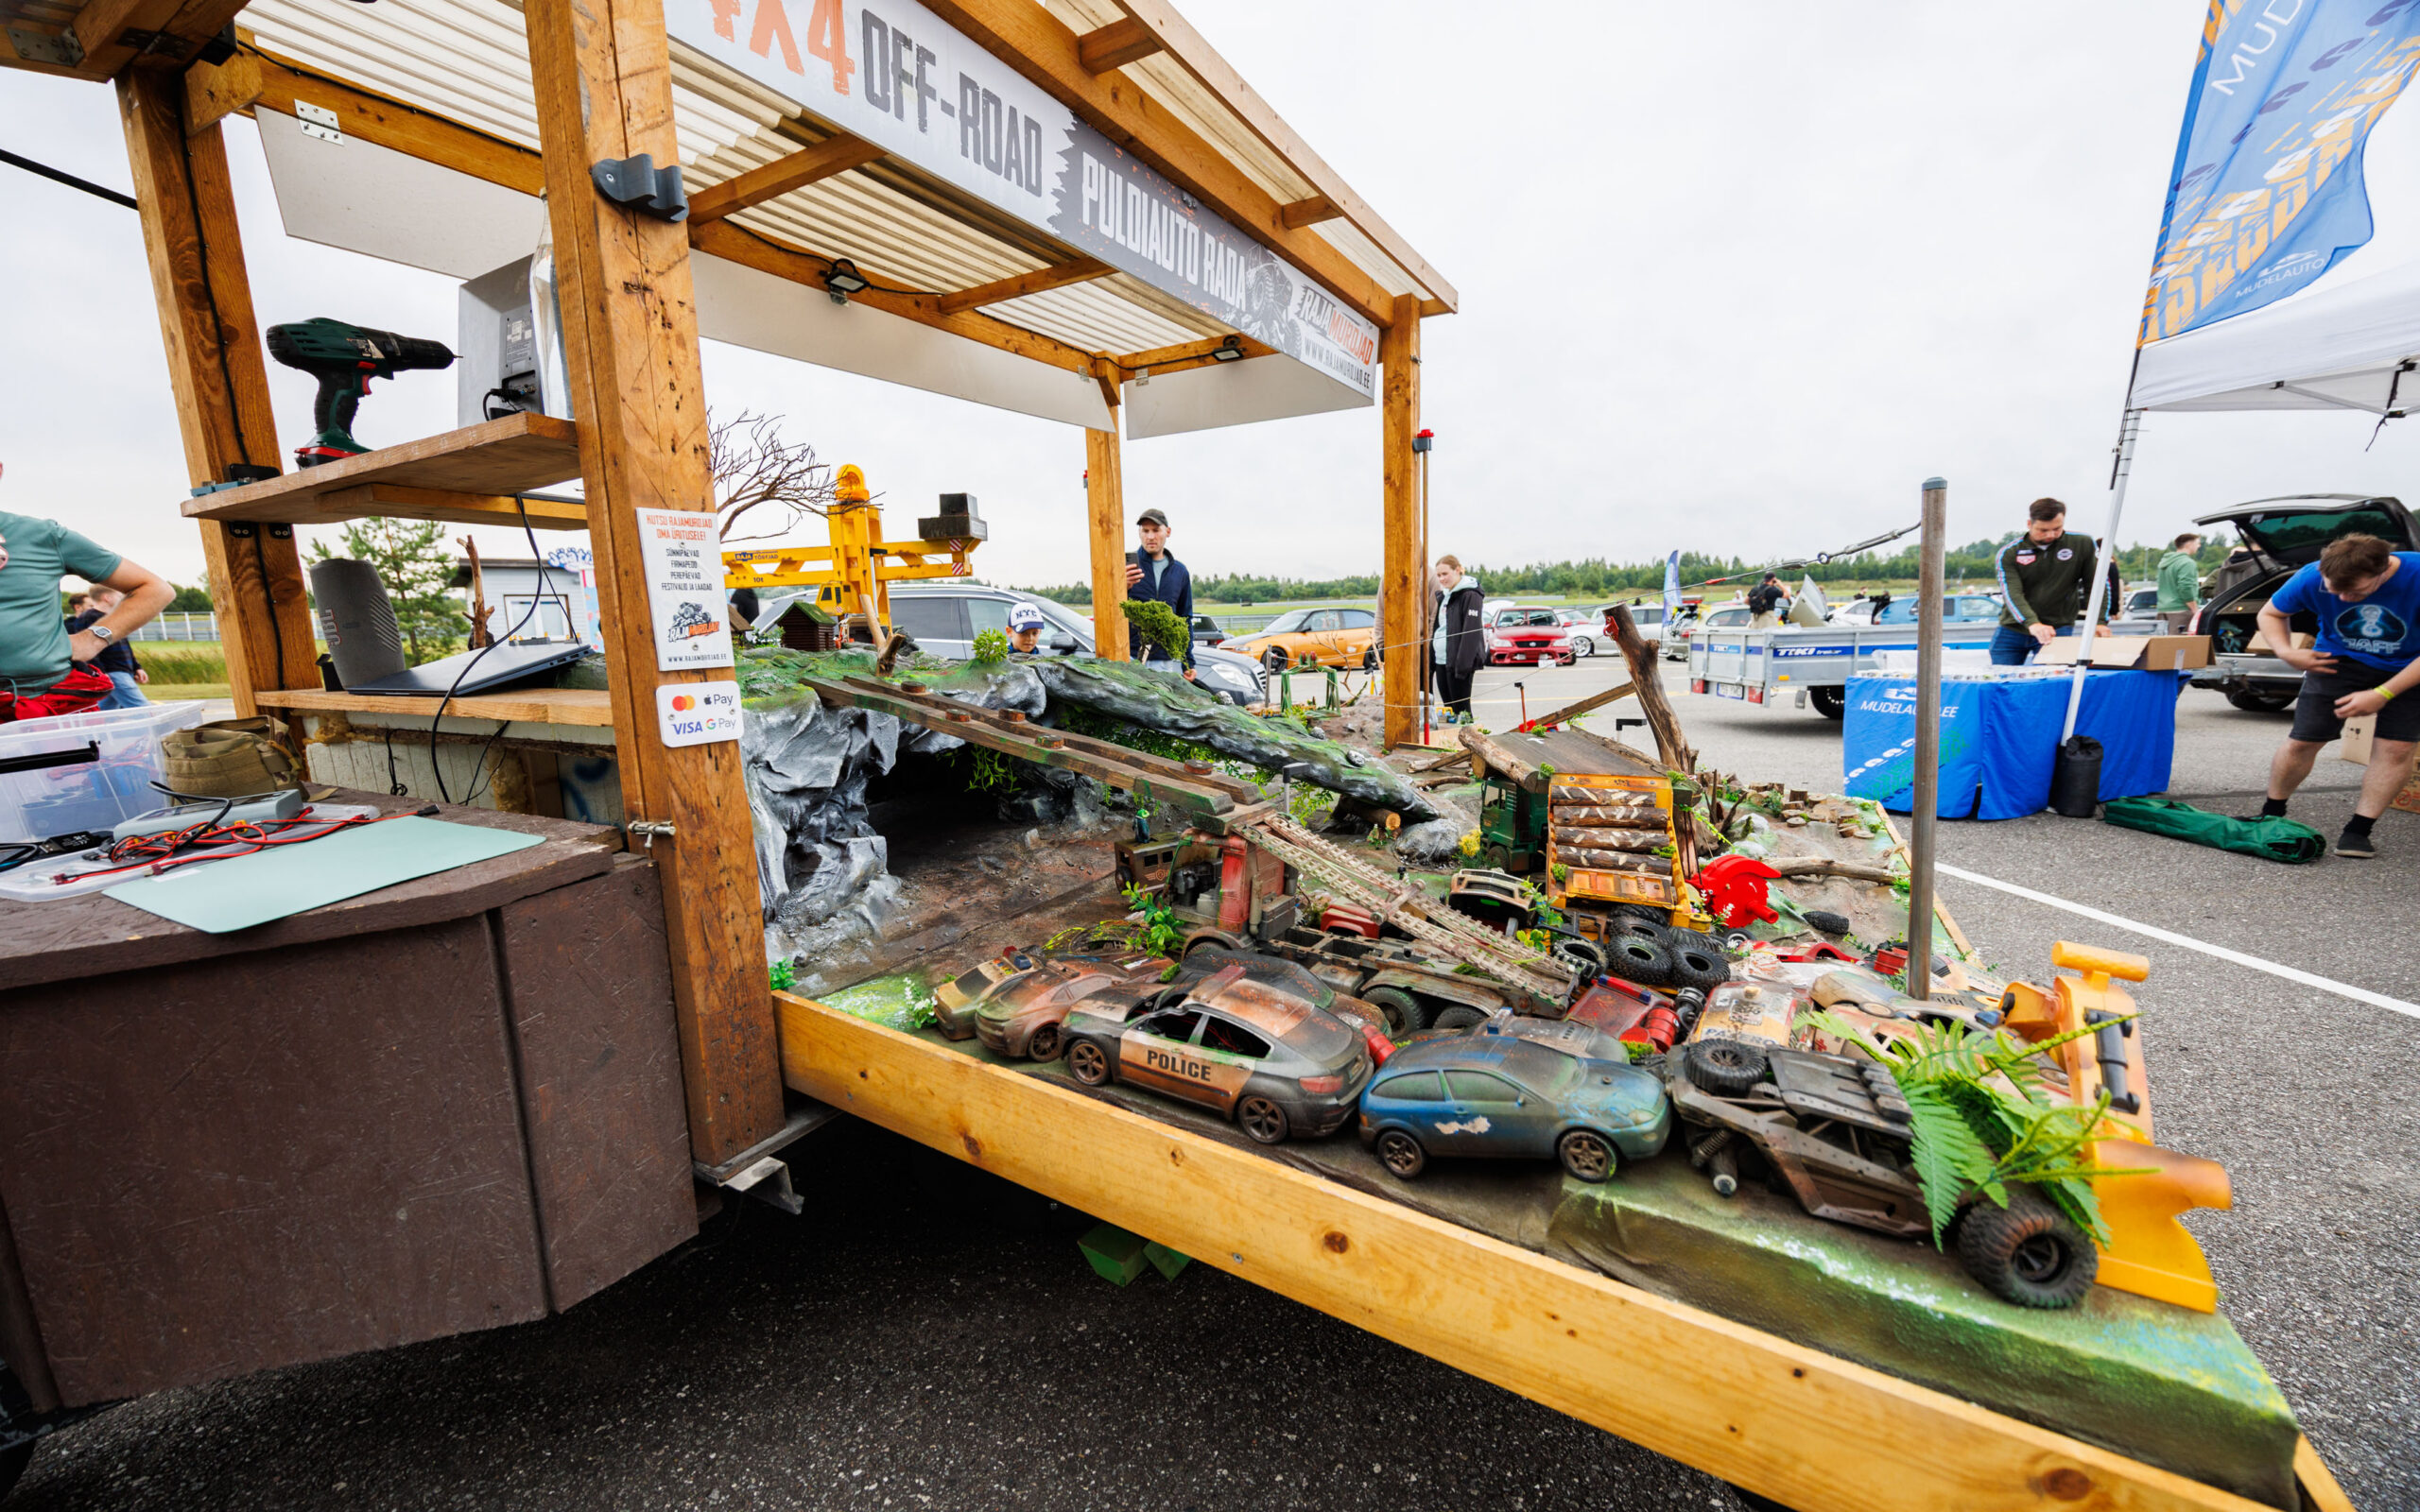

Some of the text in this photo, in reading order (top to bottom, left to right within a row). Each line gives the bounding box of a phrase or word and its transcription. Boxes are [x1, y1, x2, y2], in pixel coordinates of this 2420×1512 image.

[863, 9, 1042, 198] OFF-ROAD
[1082, 151, 1246, 312] PULDIAUTO RADA
[2235, 258, 2325, 299] MUDELAUTO
[647, 515, 713, 528] KUTSU RAJAMUROJAD
[656, 528, 706, 541] OMA ÜRITUSELE!
[670, 571, 701, 579] PEREPÄEVAD
[1016, 610, 1037, 619] NYC
[713, 694, 734, 706] Pay
[1860, 700, 1959, 718] MUDELA.EE
[671, 721, 703, 735] VISA
[718, 718, 736, 730] Pay
[1148, 1050, 1210, 1081] POLICE
